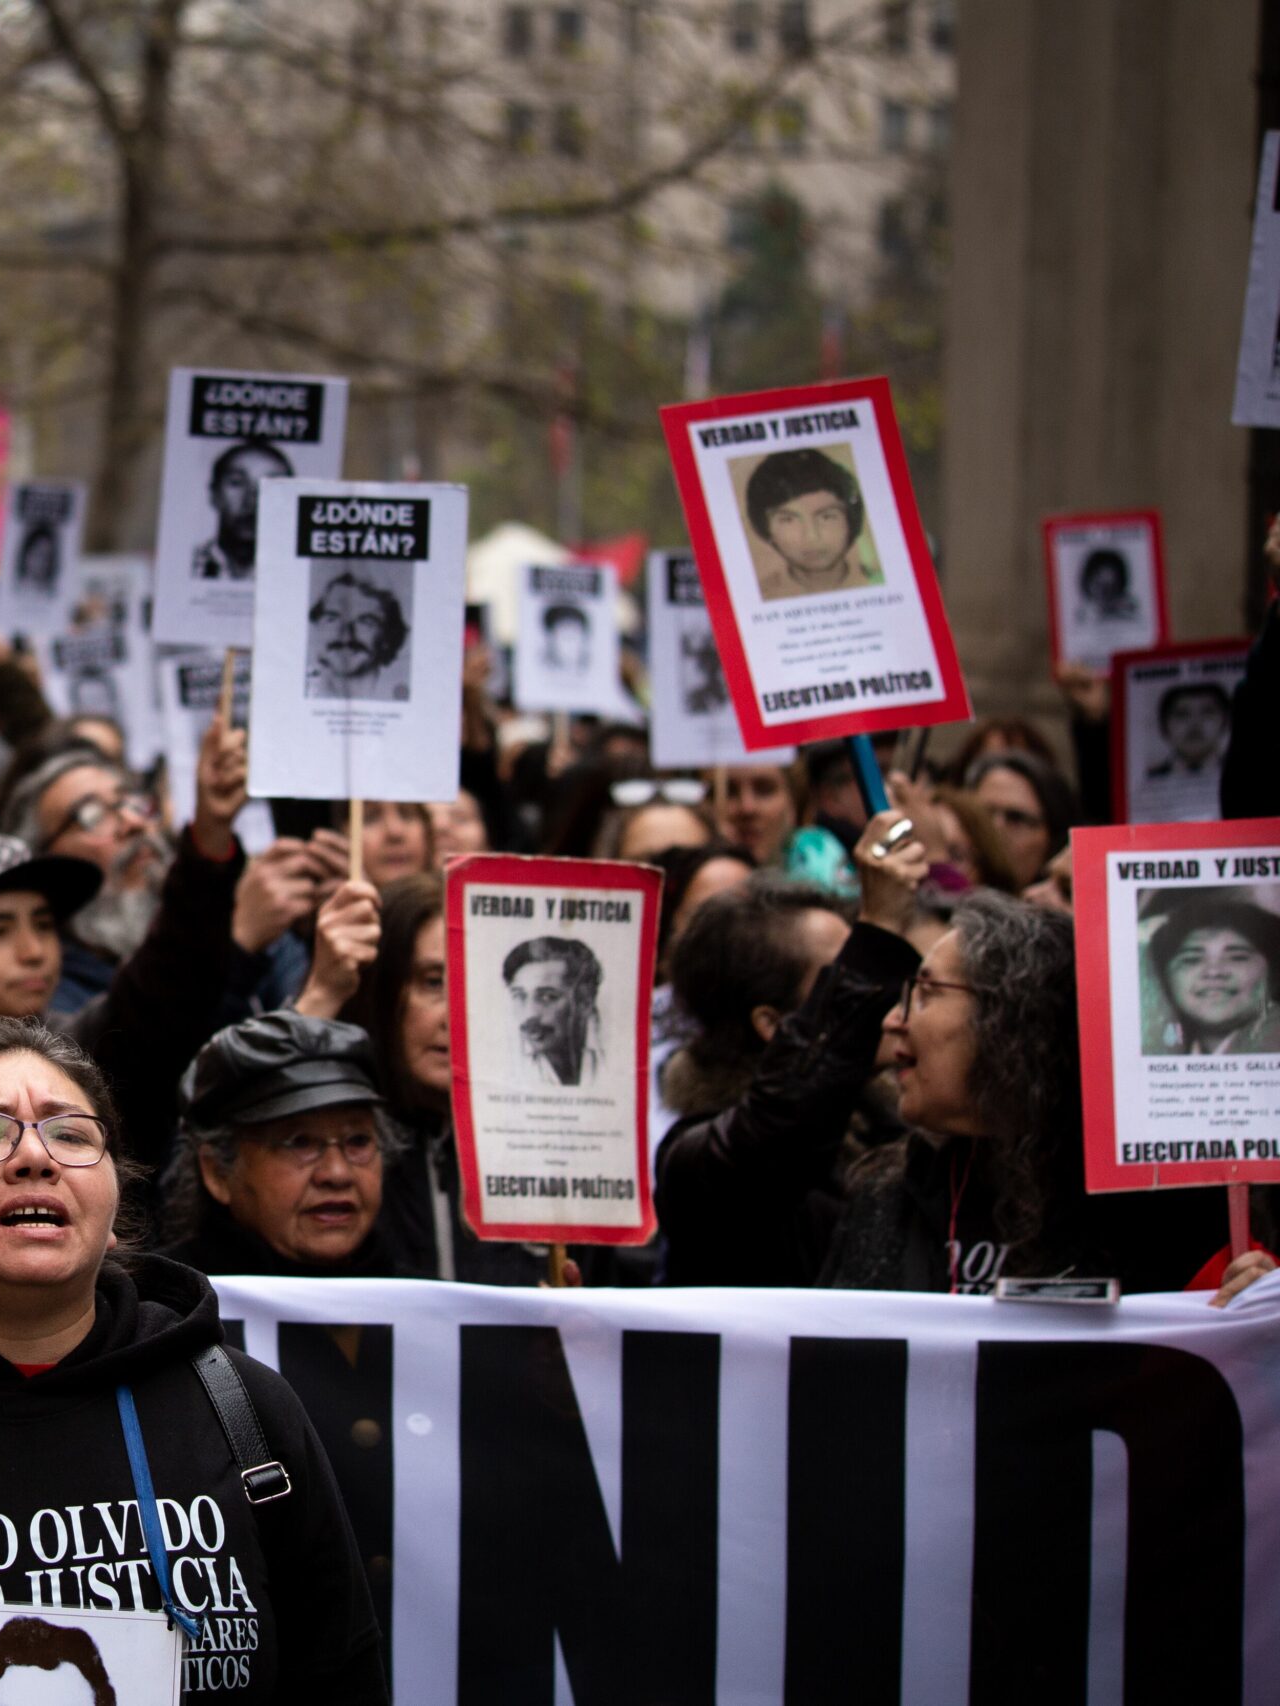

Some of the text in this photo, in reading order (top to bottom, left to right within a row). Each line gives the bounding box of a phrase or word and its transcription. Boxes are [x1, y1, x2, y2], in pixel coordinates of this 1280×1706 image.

[205, 380, 309, 411] ¿DÓNDE
[203, 410, 309, 440] ESTÁN?
[698, 408, 861, 449] VERDAD Y JUSTICIA
[311, 499, 415, 527] ¿DÓNDE
[310, 527, 416, 557] ESTÁN?
[762, 669, 933, 713] EJECUTADO POLÍTICO
[1118, 860, 1200, 880] VERDAD
[1214, 858, 1228, 878] Y
[470, 895, 632, 923] VERDAD Y JUSTICIA
[1122, 1139, 1237, 1163] EJECUTADA
[486, 1173, 635, 1200] EJECUTADO POLÍTICO
[24, 1556, 258, 1613] JUSTCIA
